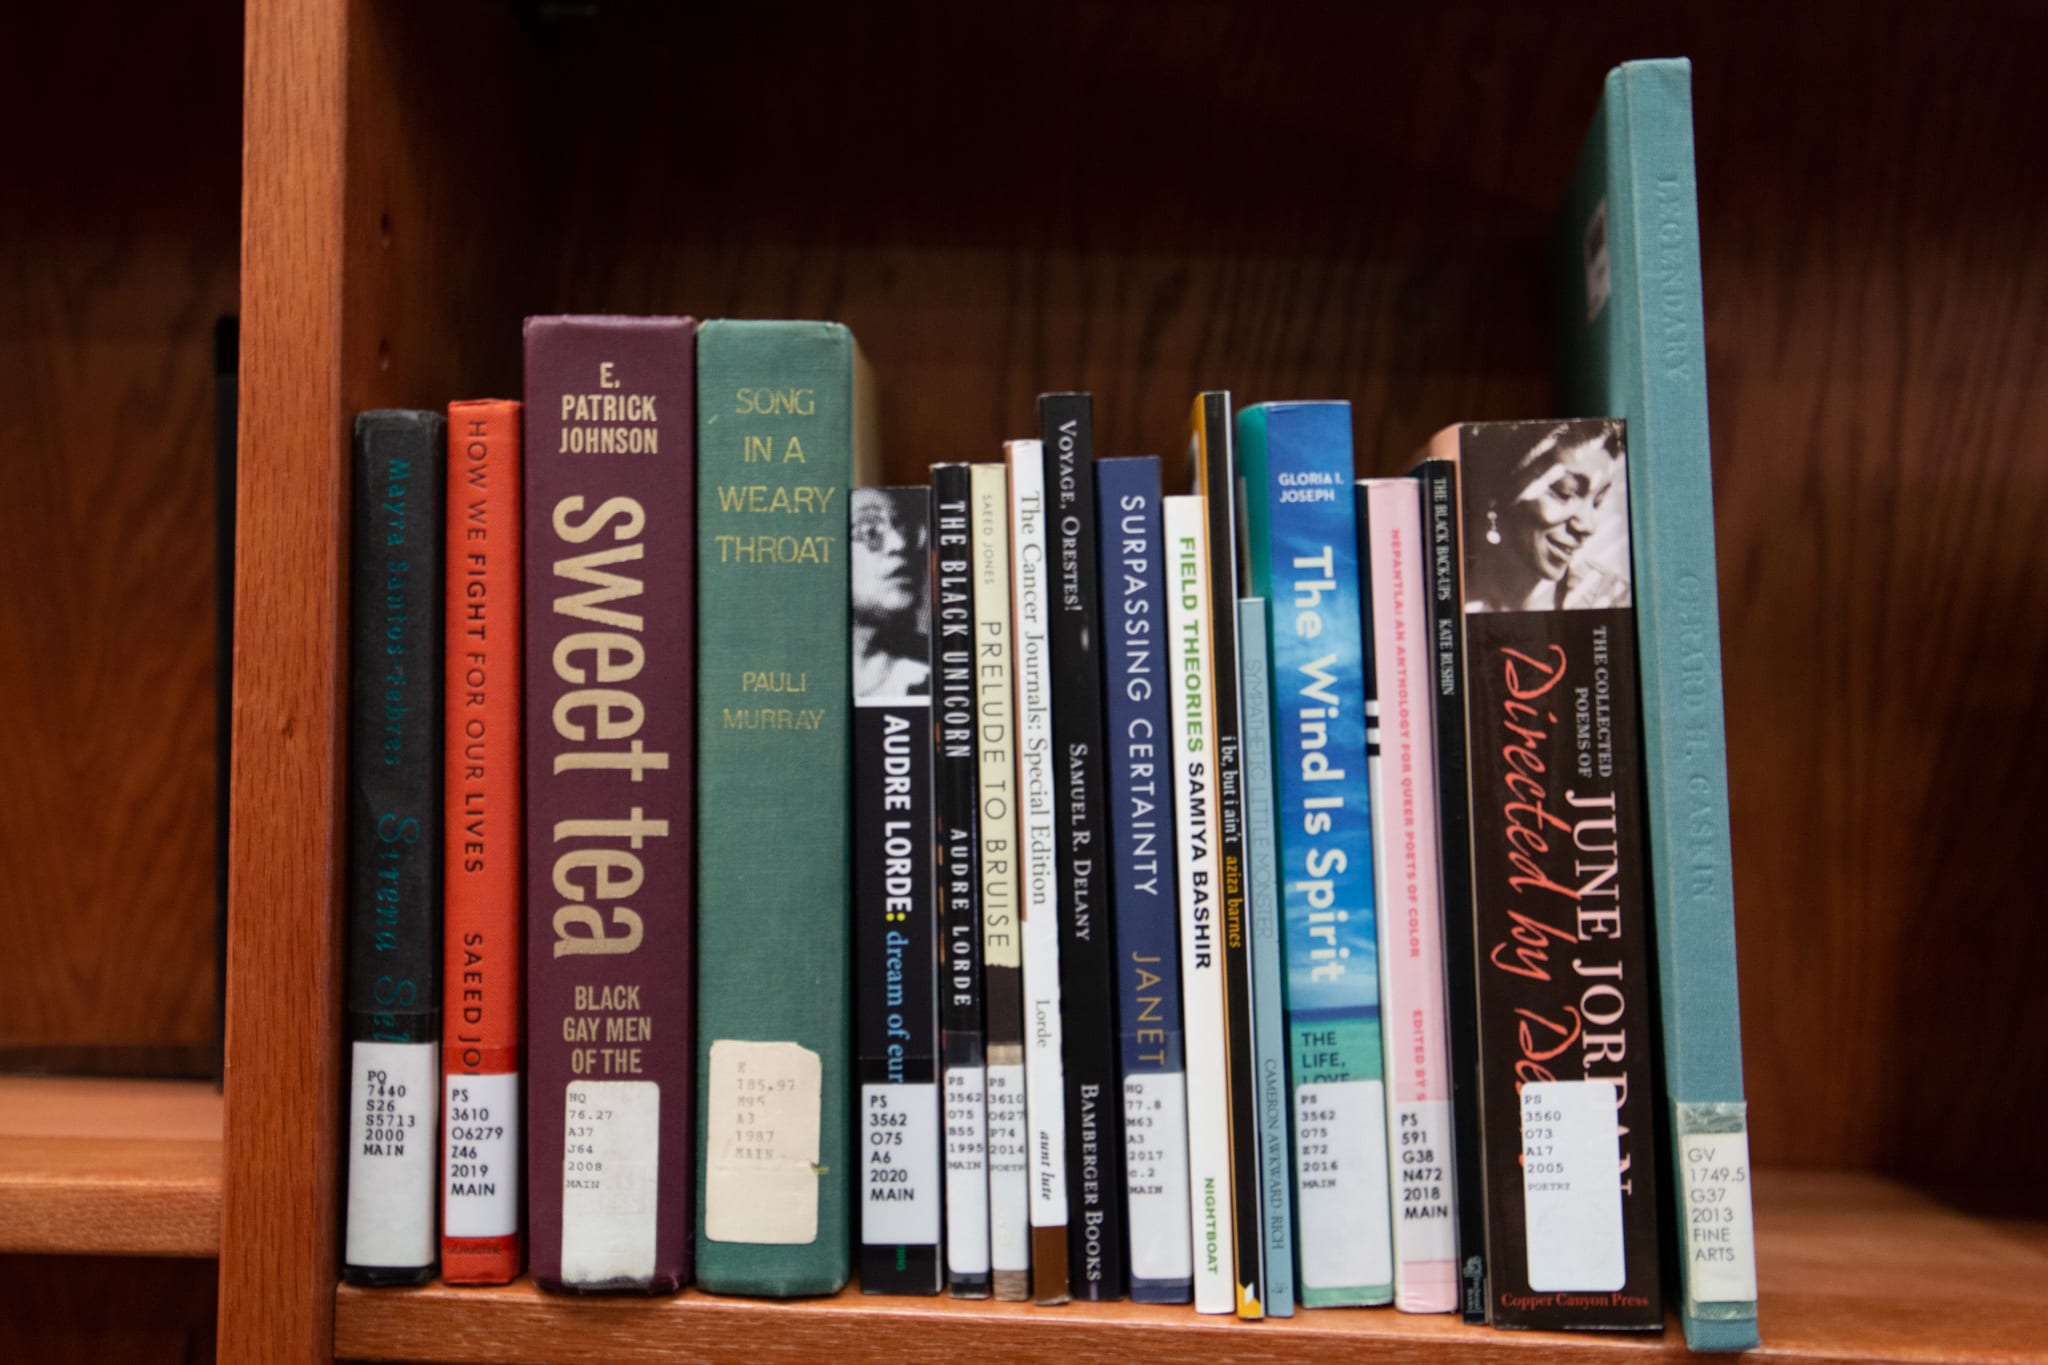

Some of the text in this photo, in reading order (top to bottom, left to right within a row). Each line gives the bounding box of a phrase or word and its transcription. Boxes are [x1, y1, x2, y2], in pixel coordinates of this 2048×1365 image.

[599, 362, 621, 390] E.
[561, 395, 657, 421] PATRICK
[735, 388, 815, 415] SONG
[559, 427, 658, 454] JOHNSON
[743, 436, 806, 464] IN A
[1278, 473, 1332, 486] GLORIA
[1433, 479, 1447, 501] THE
[383, 459, 411, 546] Mayra
[717, 485, 835, 513] WEARY
[1279, 489, 1335, 503] JOSEPH
[1435, 504, 1448, 543] BLACK
[715, 536, 835, 564] THROAT
[982, 494, 995, 585] SAEED JONES
[940, 501, 971, 758] THE BLACK UNICORN
[1395, 619, 1406, 642] AN
[464, 420, 487, 873] HOW WE FIGHT FOR OUR LIVES
[1180, 537, 1204, 753] FIELD THEORIES
[1439, 619, 1455, 696] KATE RUSHIN
[742, 672, 807, 692] PAULI
[1397, 646, 1412, 739] ANTHOLOGY
[1021, 491, 1051, 906] The Cancer Journals: Special Edition
[1121, 495, 1158, 896] SURPASSING CERTAINTY
[1593, 625, 1612, 778] THE COLLECTED
[552, 495, 669, 959] Sweet tea
[722, 708, 825, 730] MURRAY
[1575, 687, 1592, 778] POEMS OF
[884, 715, 911, 811] AUDRE
[1293, 546, 1350, 982] The Wind Is Spirit
[1401, 744, 1412, 772] FOR
[980, 622, 1009, 948] PRELUDE TO BRUISE
[1222, 770, 1239, 796] but
[1401, 777, 1414, 827] QUEER
[1490, 644, 1582, 982] Directed by
[1073, 830, 1091, 852] R.
[1189, 762, 1211, 970] SAMIYA BASHIR
[1404, 831, 1416, 879] POETS
[1565, 789, 1622, 941] JUNE
[884, 821, 912, 922] LORDE:
[1226, 855, 1242, 894] aziza
[1407, 884, 1417, 904] OF
[950, 829, 972, 1006] AUDRE LORDE
[1227, 897, 1245, 948] barnes
[1408, 908, 1420, 957] COLOR
[886, 931, 909, 1006] dream
[458, 934, 483, 1076] SAEED JO
[575, 986, 640, 1010] BLACK
[1133, 953, 1165, 1066] JANET
[563, 1017, 651, 1042] GAY MEN
[887, 1017, 911, 1040] of
[1036, 1000, 1052, 1048] Lorde
[1301, 1031, 1337, 1047] THE
[1412, 1010, 1426, 1088] EDITED BY
[571, 1049, 643, 1074] OF THE
[1302, 1052, 1346, 1069] LIFE,
[367, 1070, 387, 1086] PQ
[367, 1085, 406, 1098] 7440
[452, 1089, 469, 1102] PS
[870, 1096, 887, 1109] PS
[1264, 1059, 1279, 1129] CAMERON
[366, 1099, 395, 1112] S26
[452, 1108, 489, 1121] 3610
[1301, 1110, 1336, 1121] 3562
[1525, 1111, 1562, 1122] 3560
[366, 1115, 415, 1128] S5713
[870, 1113, 907, 1127] 3562
[1401, 1113, 1418, 1127] PS
[366, 1129, 404, 1142] 2000
[1401, 1131, 1427, 1145] 591
[363, 1144, 405, 1156] MAIN
[451, 1146, 477, 1159] Z46
[870, 1151, 891, 1164] A6
[1128, 1151, 1164, 1161] 2017
[1402, 1150, 1434, 1164] G38
[1688, 1148, 1716, 1162] GV
[451, 1164, 488, 1178] 2019
[567, 1162, 603, 1172] 2008
[870, 1169, 907, 1182] 2020
[1040, 1131, 1056, 1201] aunt lute
[1302, 1162, 1338, 1172] 2016
[1403, 1168, 1442, 1182] N472
[1527, 1163, 1564, 1173] 2005
[1690, 1168, 1745, 1182] 1749.5
[451, 1183, 496, 1197] MAIN
[870, 1188, 915, 1201] MAIN
[1129, 1185, 1163, 1195] MAIN
[1404, 1187, 1440, 1201] 2018
[1691, 1188, 1726, 1203] G37
[1404, 1205, 1448, 1219] MAIN
[1692, 1209, 1733, 1223] 2013
[1204, 1177, 1218, 1275] NIGHTBOAT
[1694, 1228, 1730, 1243] FINE
[1695, 1248, 1735, 1262] ARTS
[1501, 1293, 1553, 1311] Copper
[1555, 1293, 1608, 1310] Canyon
[1612, 1293, 1648, 1307] Press
